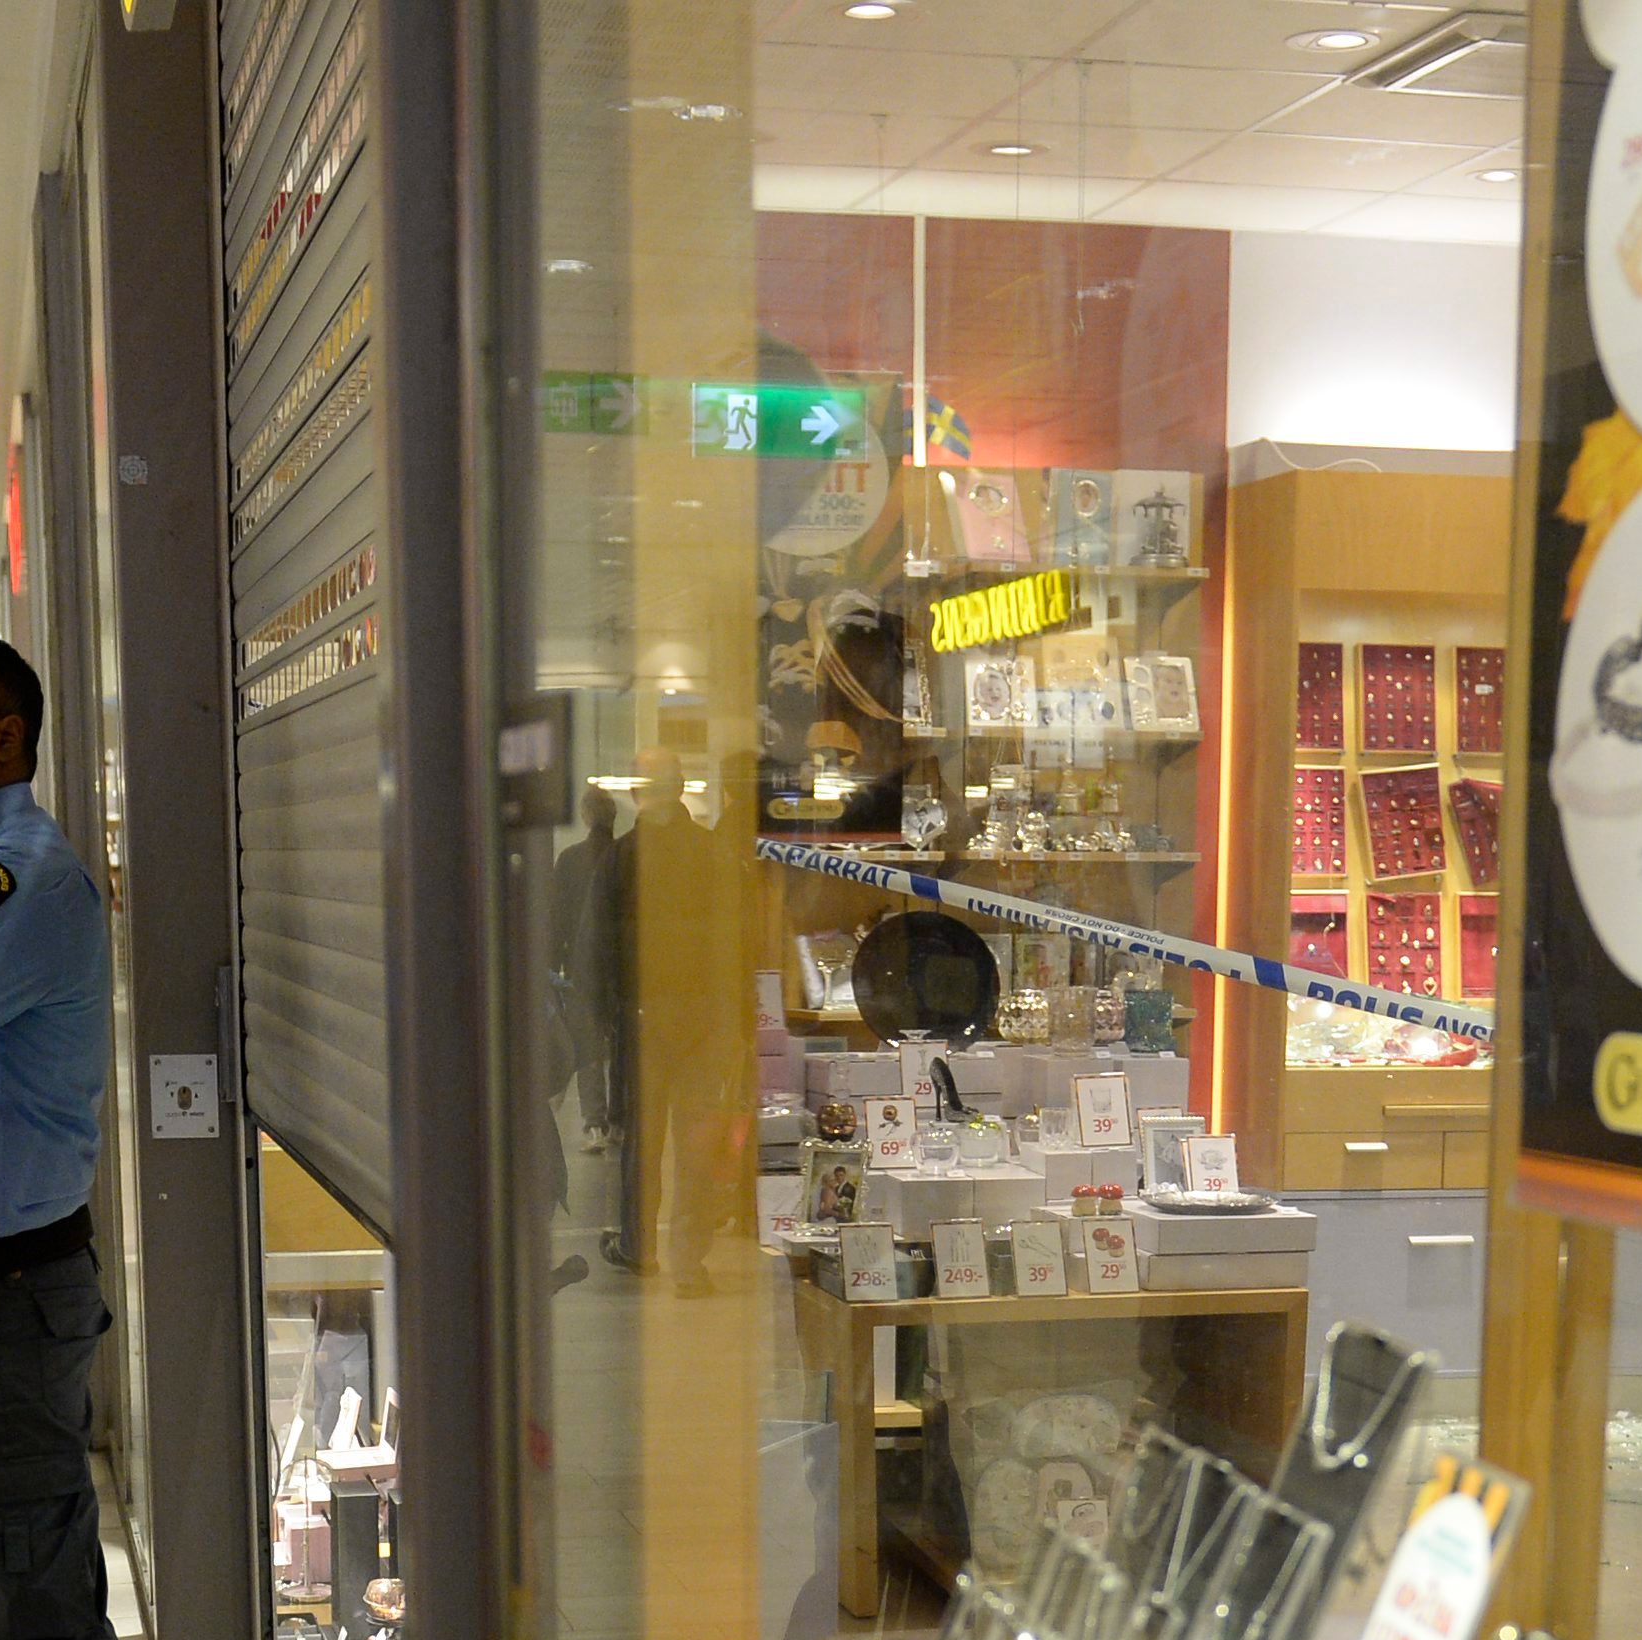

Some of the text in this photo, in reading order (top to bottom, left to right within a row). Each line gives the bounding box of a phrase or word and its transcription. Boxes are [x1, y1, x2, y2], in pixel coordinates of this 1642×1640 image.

[1079, 916, 1103, 930] NOT
[1104, 923, 1121, 933] DO
[851, 1267, 892, 1287] 298:-
[944, 1267, 984, 1284] 249:-
